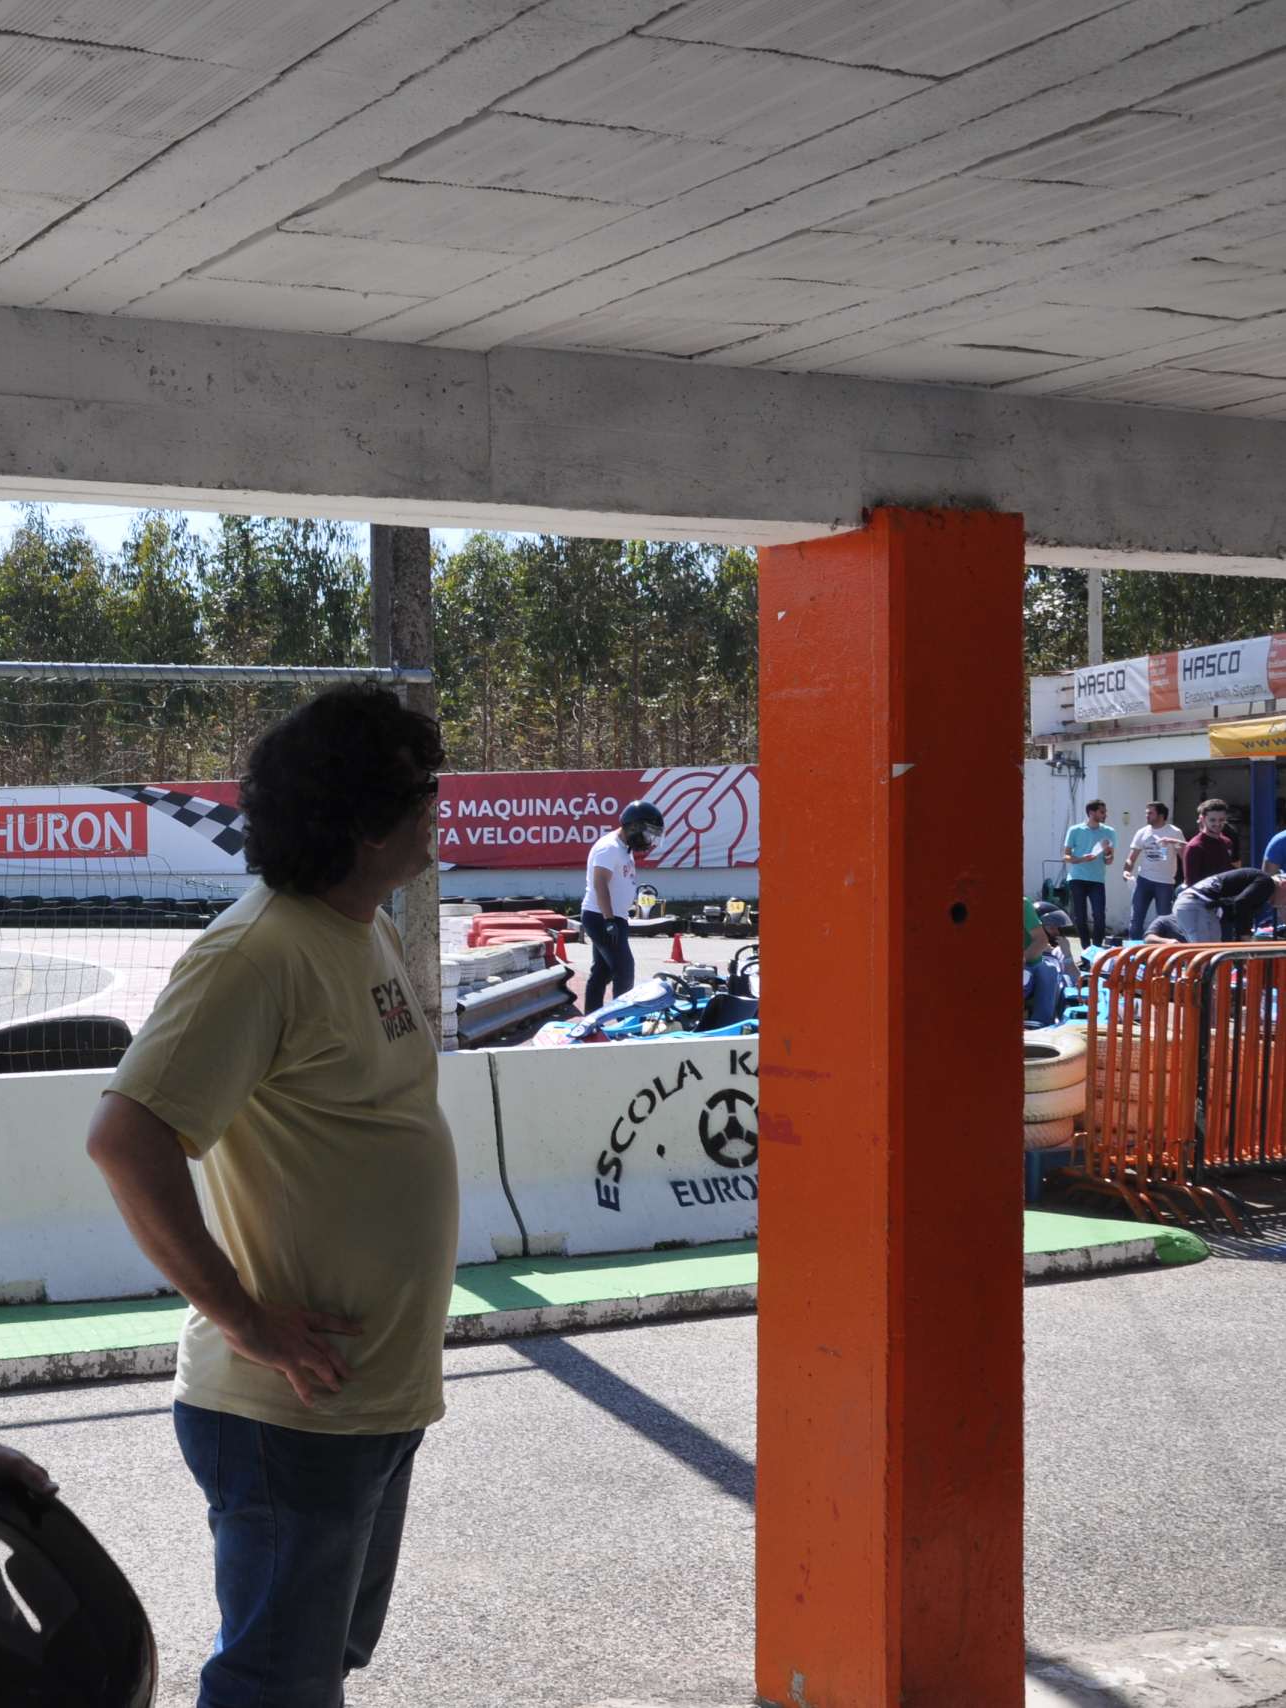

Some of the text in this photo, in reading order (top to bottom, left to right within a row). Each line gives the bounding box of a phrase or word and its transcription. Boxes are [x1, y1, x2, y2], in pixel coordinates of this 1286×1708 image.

[1182, 650, 1241, 681] HASCO
[1077, 669, 1126, 697] HASCO
[437, 792, 619, 821] S MAQUINAÇÃO
[437, 826, 461, 846] TA
[595, 1049, 759, 1212] ESCOLA K
[669, 1173, 759, 1208] EURO
